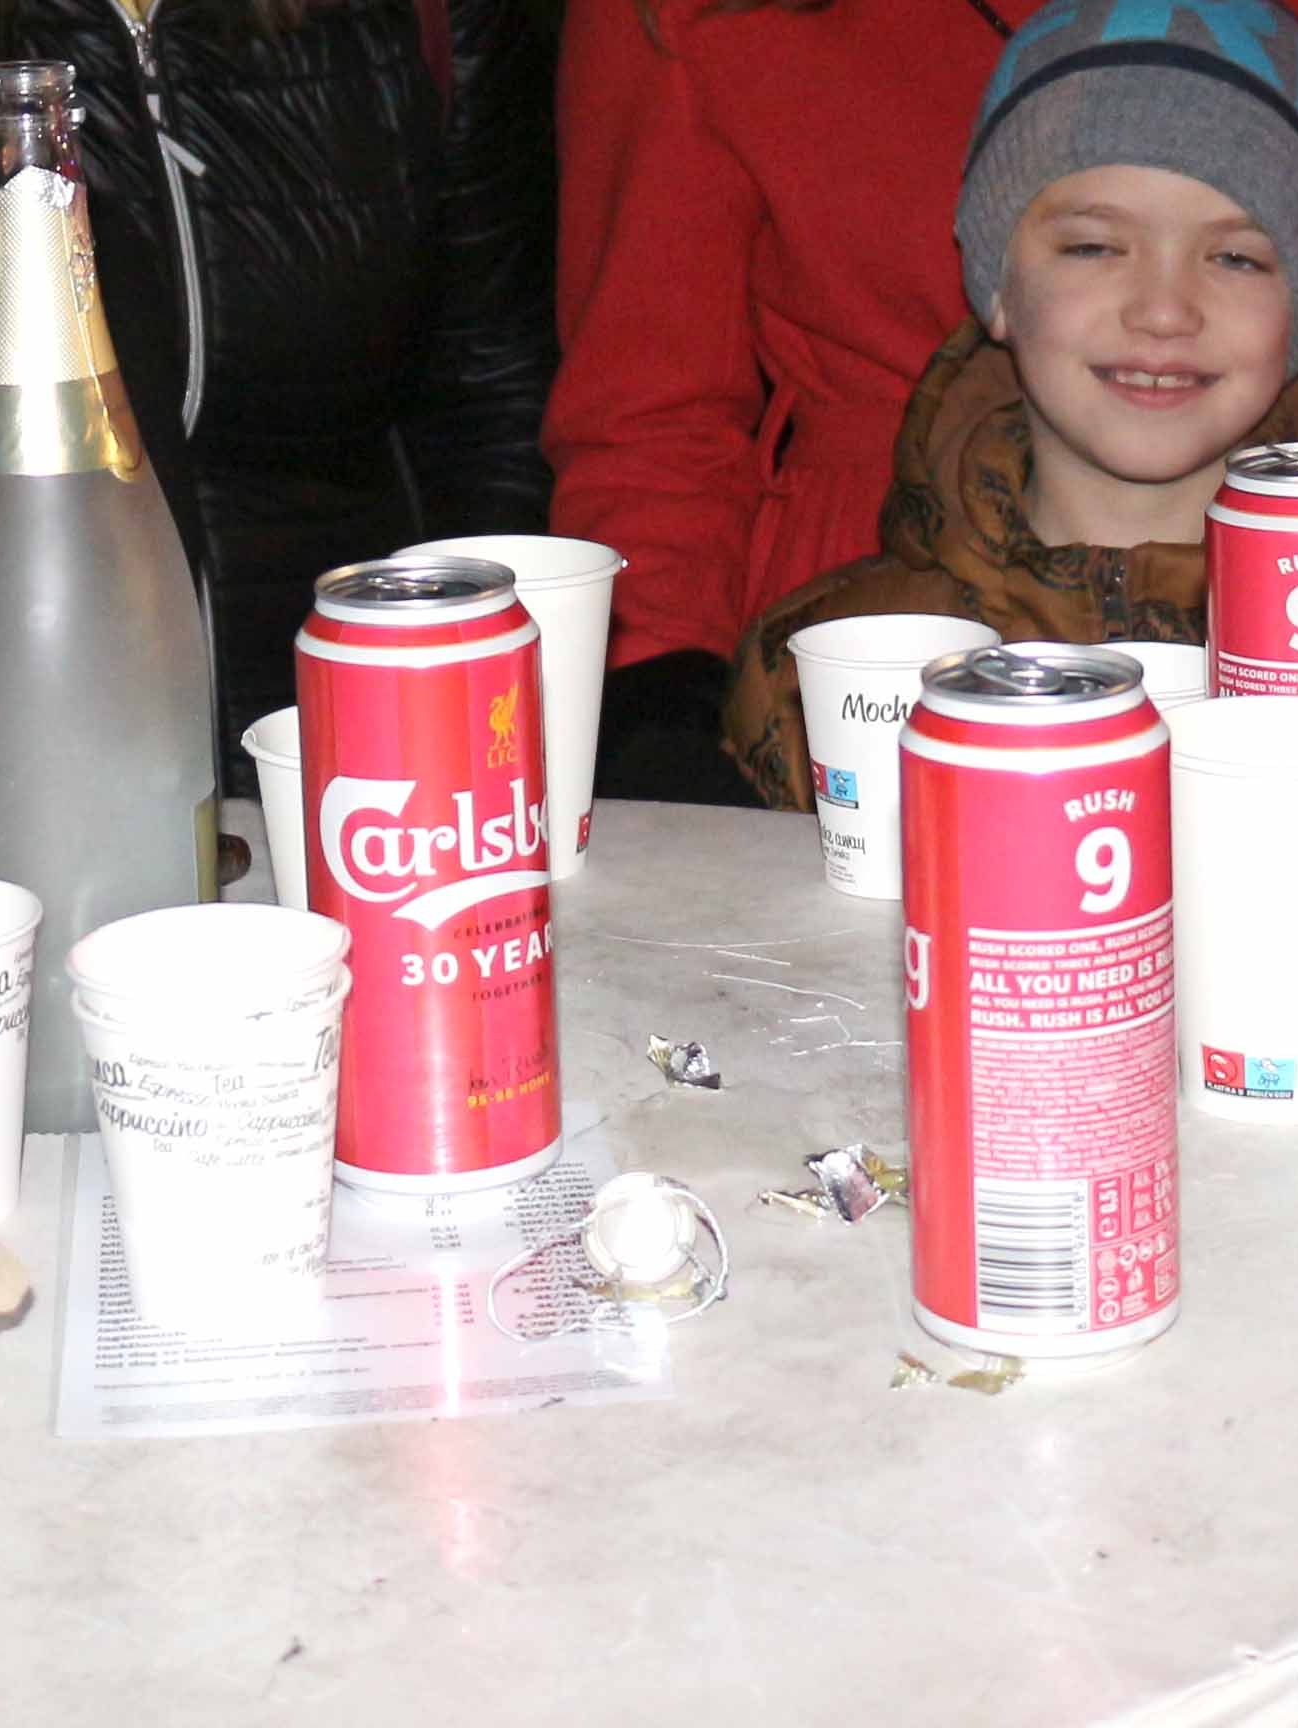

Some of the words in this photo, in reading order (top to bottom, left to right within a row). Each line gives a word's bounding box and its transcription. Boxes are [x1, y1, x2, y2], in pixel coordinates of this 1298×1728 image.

[1235, 679, 1267, 692] SCORED
[1268, 683, 1297, 694] THREE
[1238, 666, 1277, 681] SCORED
[841, 692, 915, 724] Moch
[487, 744, 519, 768] LFC
[1063, 789, 1136, 822] RUSH
[1075, 826, 1132, 915] 9
[967, 940, 1006, 954] RUSH
[1007, 943, 1067, 957] SCORED
[1104, 932, 1136, 950] RUSH
[401, 952, 459, 986] 30
[968, 956, 1000, 969] RUSH
[1002, 959, 1052, 971] SCORED
[1053, 956, 1092, 970] THREE
[1093, 953, 1117, 967] AND
[969, 971, 1011, 993] ALL
[1015, 973, 1071, 995] YOU
[1077, 963, 1134, 992] NEED
[1137, 955, 1154, 979] IS
[970, 994, 991, 1007] ALL
[992, 996, 1020, 1009] YOU
[1021, 997, 1055, 1010] NEED
[970, 1007, 1026, 1029] RUSH.
[1028, 1010, 1081, 1029] RUSH
[1084, 1008, 1104, 1026] IS
[1105, 1001, 1136, 1023] ALL
[1136, 989, 1162, 1013] YOU
[100, 1097, 209, 1138] appuccino
